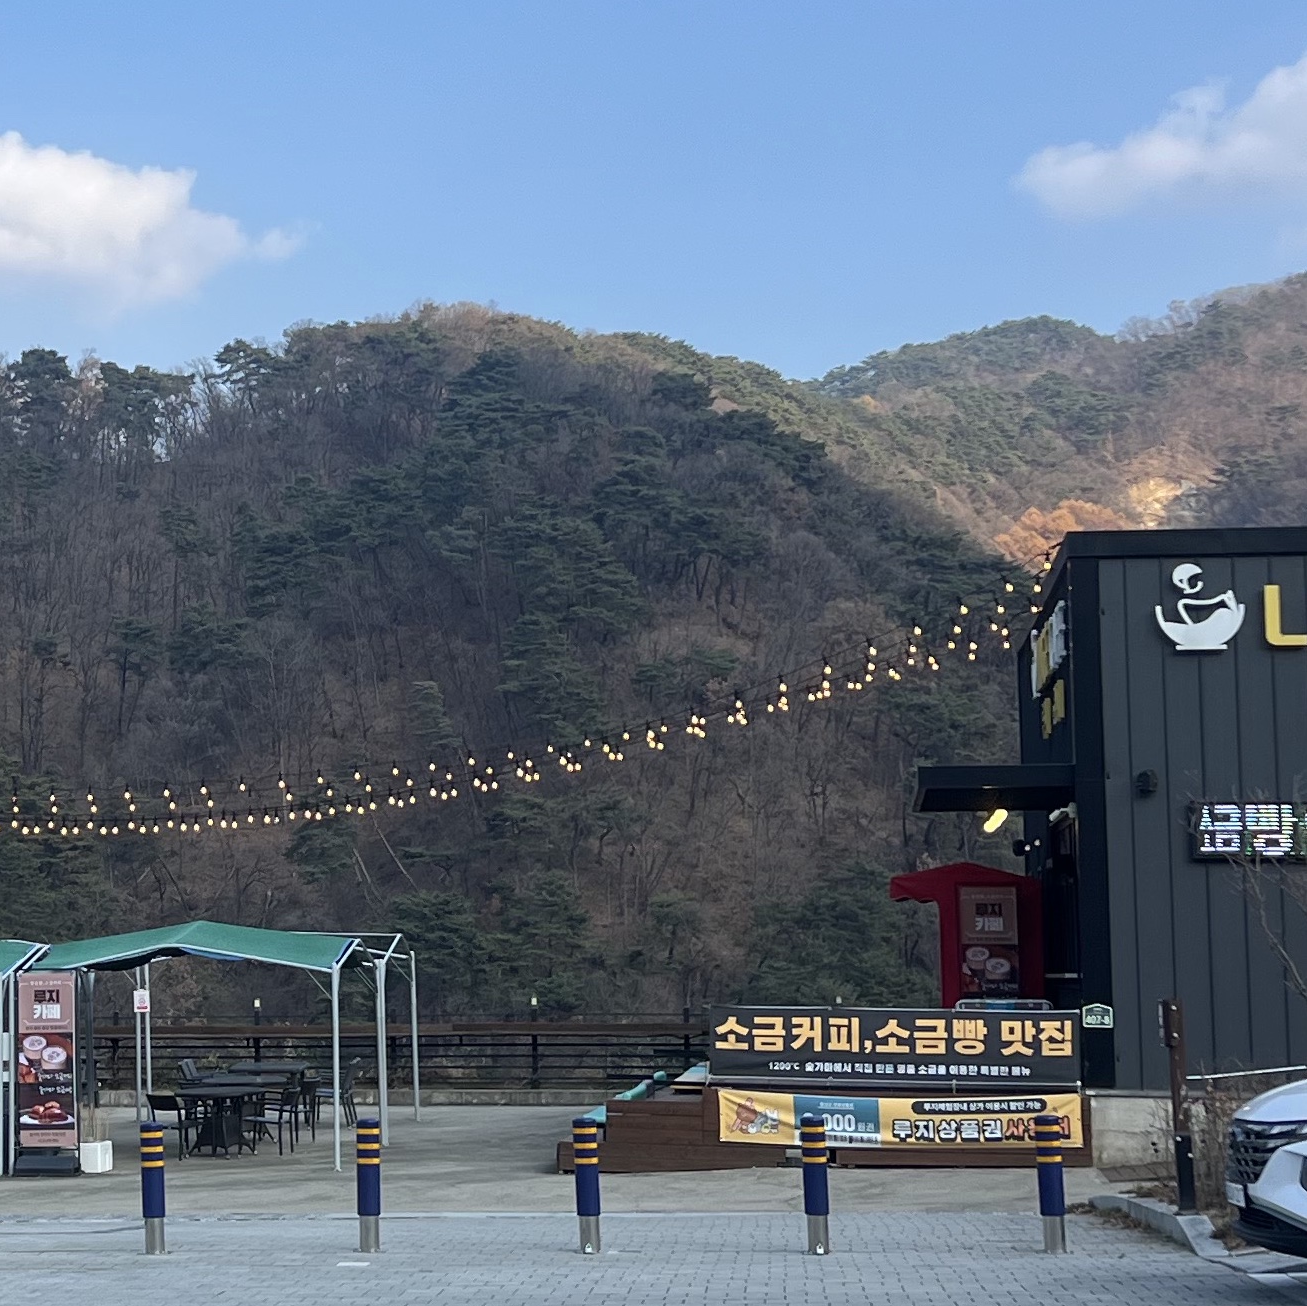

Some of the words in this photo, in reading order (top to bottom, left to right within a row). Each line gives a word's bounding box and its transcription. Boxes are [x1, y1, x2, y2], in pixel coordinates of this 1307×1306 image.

[34, 989, 60, 1003] 루지
[33, 1004, 61, 1019] 카페
[714, 1015, 988, 1056] 소금커피,소금빵
[1000, 1019, 1073, 1056] 맛집
